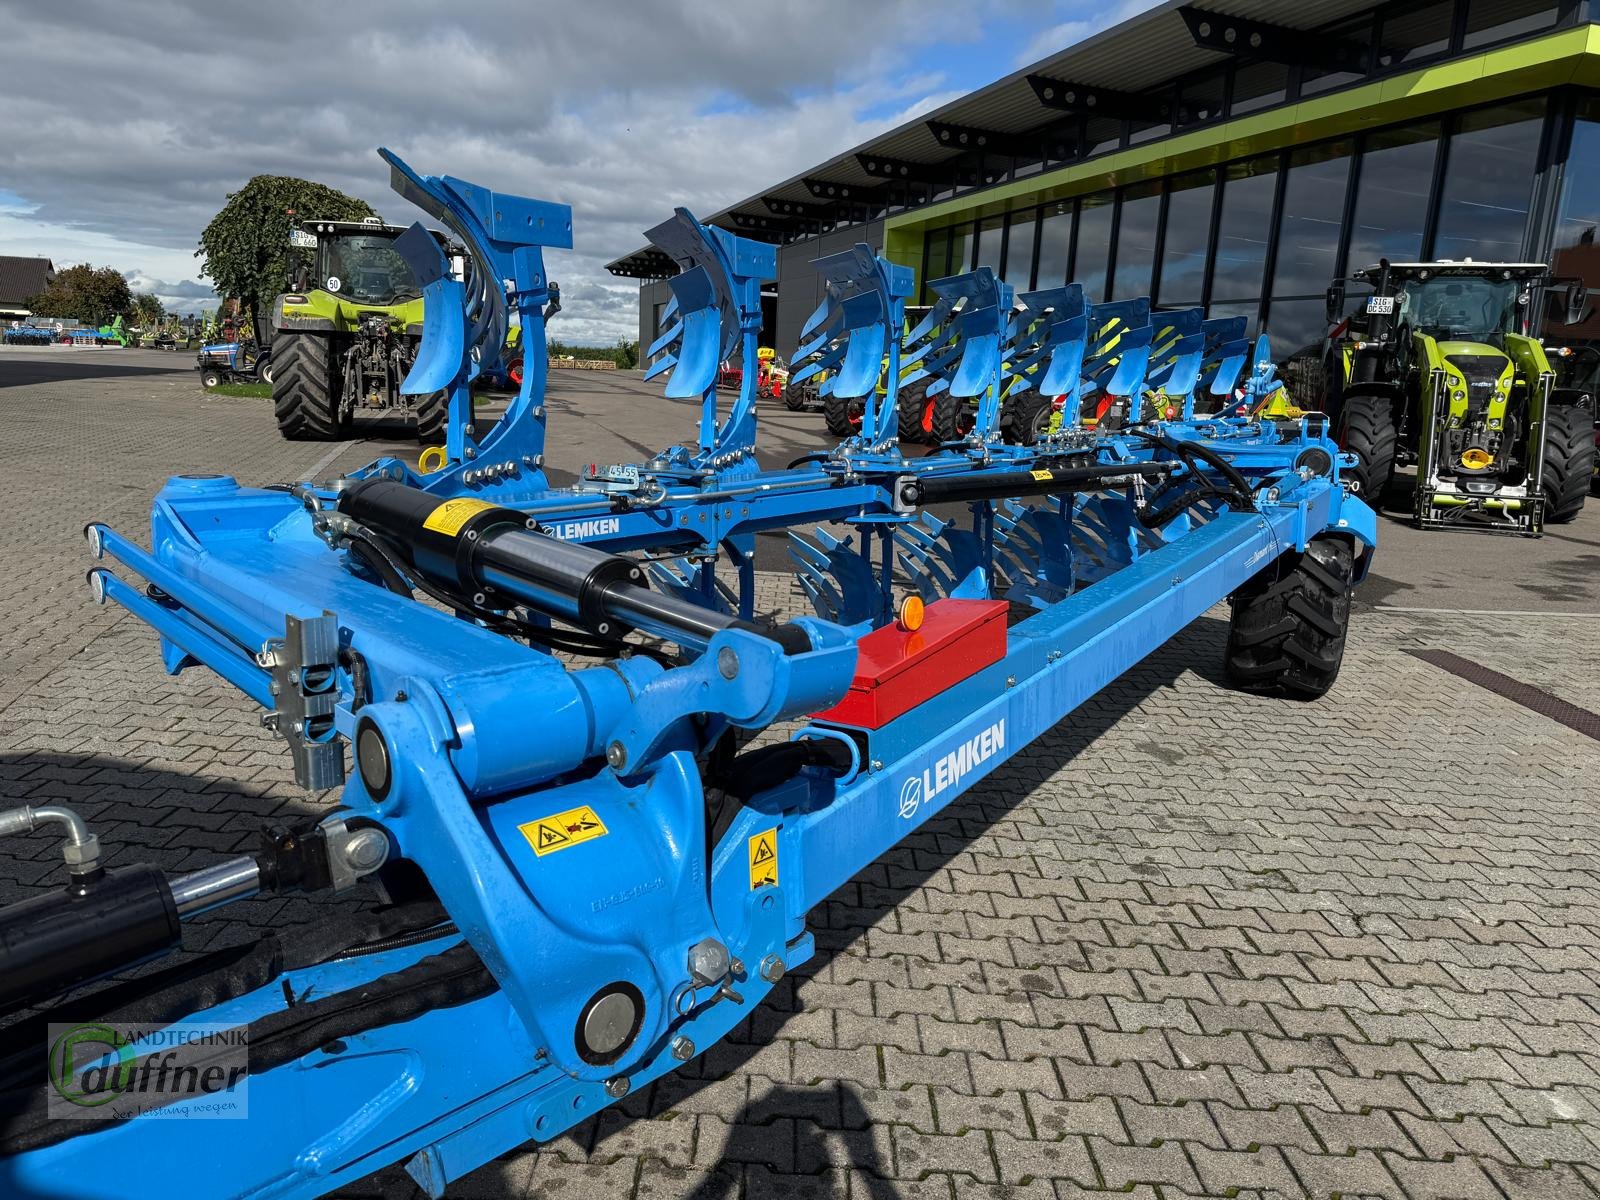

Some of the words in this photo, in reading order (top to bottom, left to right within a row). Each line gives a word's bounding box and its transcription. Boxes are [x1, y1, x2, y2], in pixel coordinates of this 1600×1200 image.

[295, 231, 309, 239] SIG
[304, 239, 317, 247] 660
[329, 279, 339, 290] 50
[1373, 298, 1388, 306] SIG
[1368, 305, 1377, 313] DC
[1378, 306, 1392, 314] 530
[556, 518, 620, 541] LEMKEN
[923, 718, 1005, 804] LEMKEN
